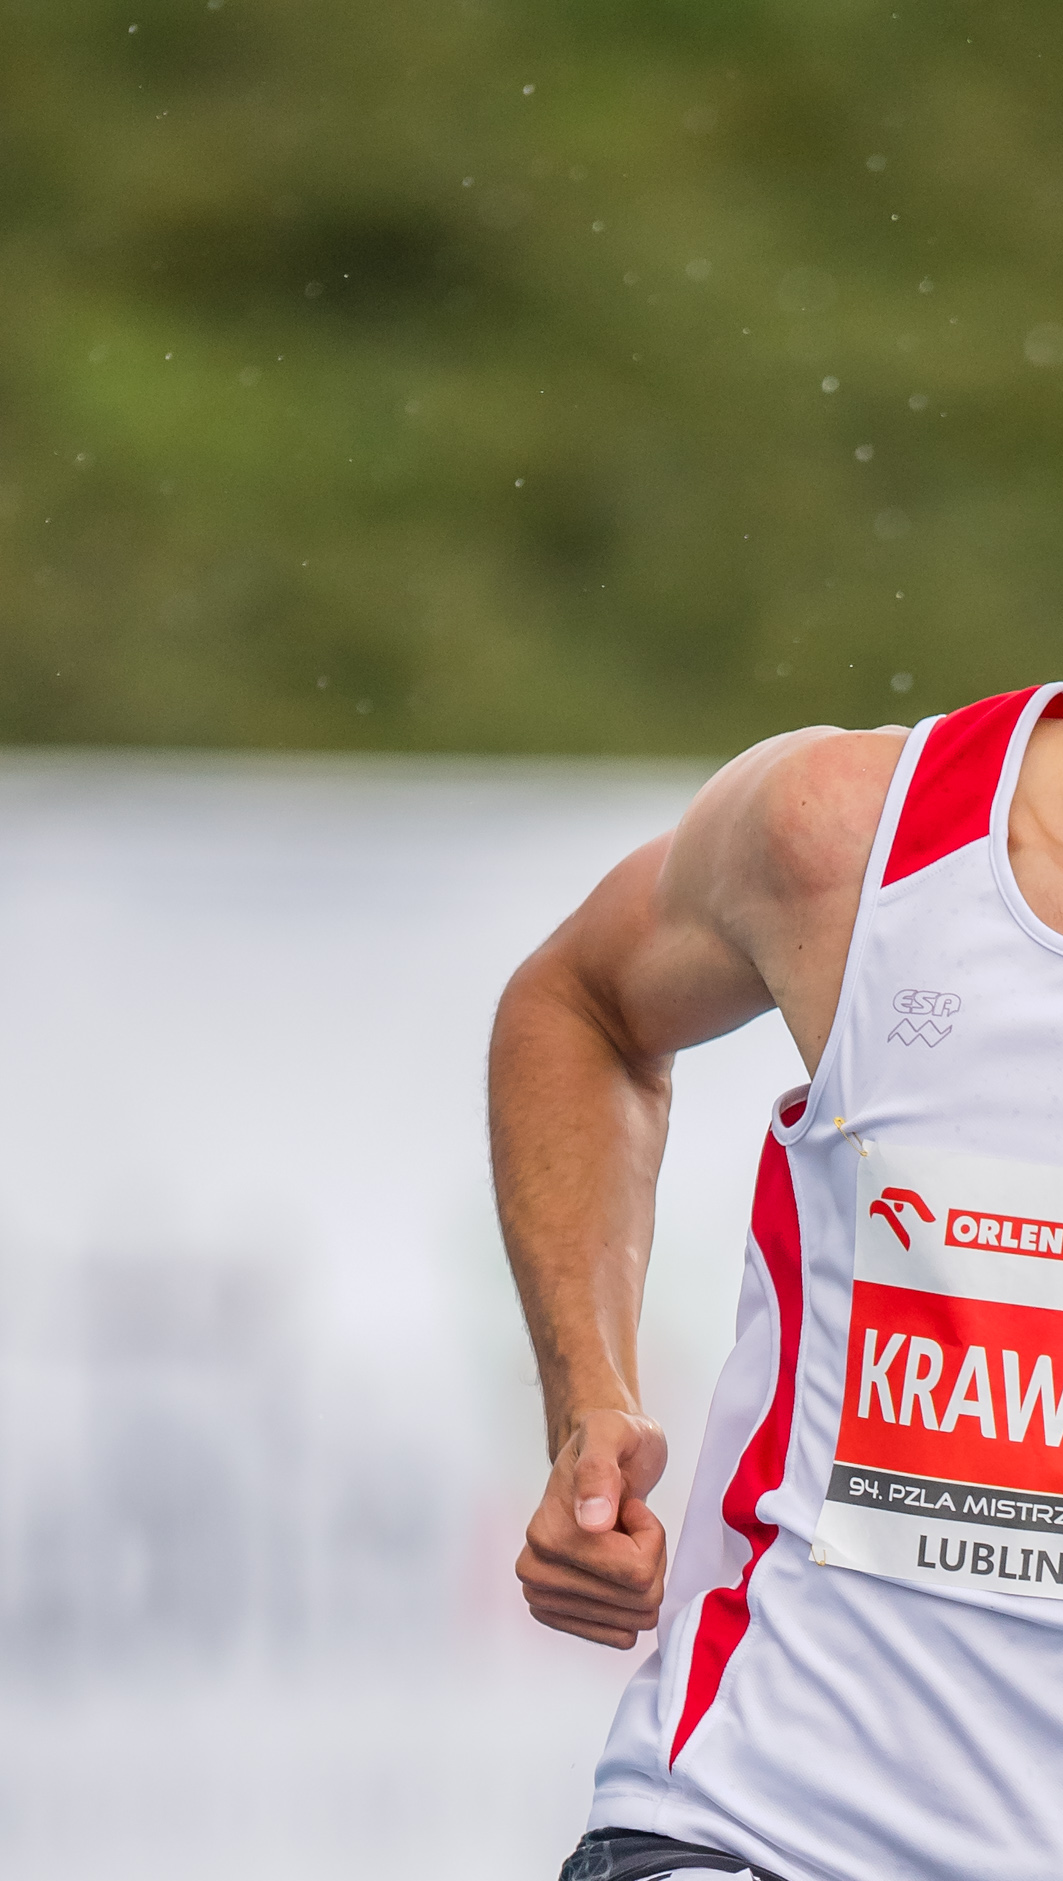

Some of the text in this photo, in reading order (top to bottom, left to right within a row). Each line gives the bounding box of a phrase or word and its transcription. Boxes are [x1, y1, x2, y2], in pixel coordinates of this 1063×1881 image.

[952, 1215, 1063, 1254] ORLEN
[848, 1477, 883, 1501] 94.
[888, 1484, 956, 1512] PZLA
